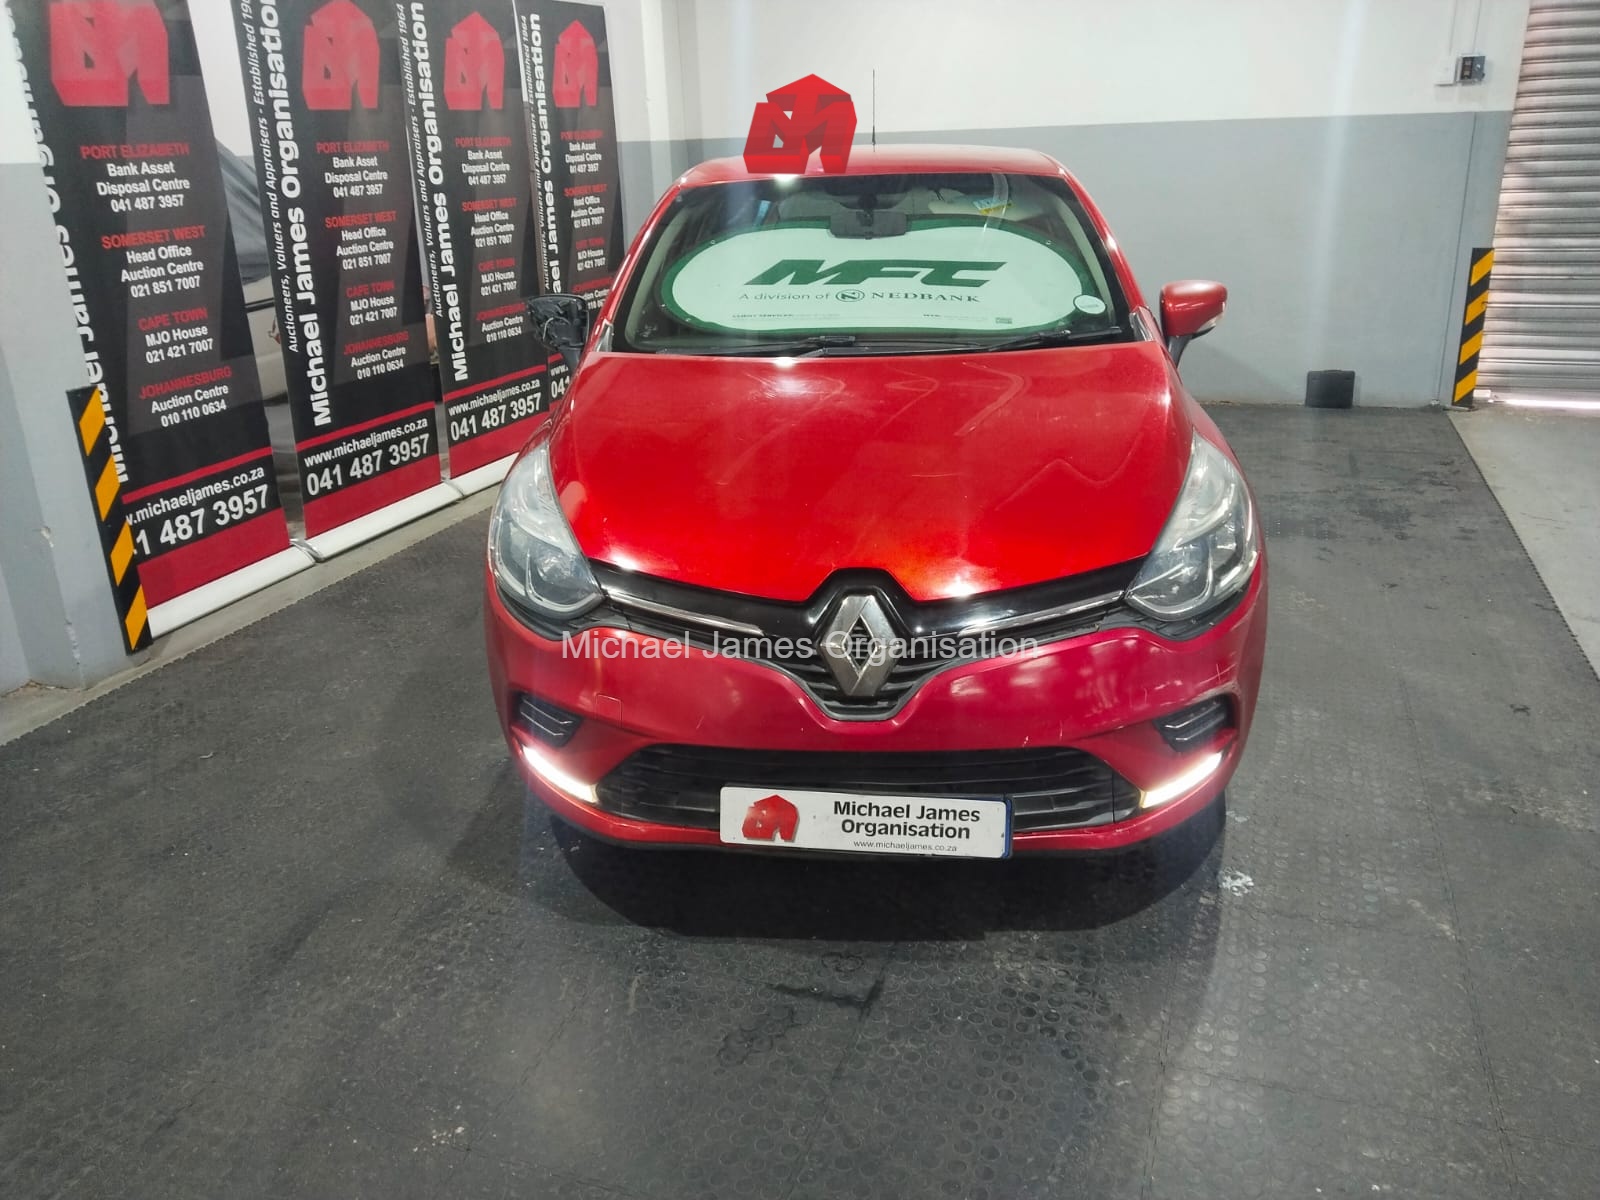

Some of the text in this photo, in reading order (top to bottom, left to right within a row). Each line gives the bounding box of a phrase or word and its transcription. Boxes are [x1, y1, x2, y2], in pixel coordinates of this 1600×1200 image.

[396, 3, 407, 34] 1964
[243, 23, 264, 105] Established
[400, 36, 416, 105] Established
[530, 13, 552, 174] Organisation
[80, 143, 190, 159] PORT ELIZABETH
[259, 115, 277, 190] Appraisers
[411, 115, 425, 178] Appraisers
[106, 161, 175, 177] Bank Asset
[332, 156, 378, 169] Bank Asset
[96, 177, 190, 197] Disposal Centre
[324, 170, 388, 185] Disposal Centre
[110, 194, 184, 212] 041 487 3957
[333, 184, 383, 198] 041 487 3957
[410, 2, 469, 381] Michael James Organisation
[418, 179, 428, 202] and
[266, 191, 280, 218] and
[544, 180, 558, 254] James
[101, 225, 205, 249] SOMERSET WEST
[341, 227, 386, 241] Head Office
[423, 205, 434, 246] Valuers
[126, 244, 192, 264] Head Office
[272, 222, 287, 270] Valuers
[288, 207, 315, 305] James
[336, 241, 394, 256] Auction Centre
[121, 260, 204, 283] Auction Centre
[342, 253, 391, 270] 021 851 7007
[743, 258, 1008, 288] MFC
[130, 275, 200, 298] 021 851 7007
[431, 250, 443, 317] Auctioneers,
[350, 295, 394, 312] MJO House
[754, 292, 810, 301] division
[815, 292, 830, 301] of
[871, 292, 980, 302] NEDBANK
[138, 307, 208, 331] CAPE TOWN
[280, 274, 298, 352] Auctioneers,
[350, 307, 398, 326] 021 421 7007
[145, 325, 208, 347] MJO House
[145, 338, 214, 364] 021 421 7007
[350, 346, 406, 367] Auction Centre
[299, 313, 332, 426] Michael
[357, 359, 404, 380] 010 110 0634
[140, 366, 232, 399] JOHANNESBURG
[150, 383, 229, 414] Auction Centre
[448, 378, 540, 416] www.michaeljames.co.za
[160, 399, 227, 427] 010 110 0634
[450, 392, 541, 441] 041 487 3957
[304, 417, 428, 468] www.michaeljames.co.za
[306, 433, 430, 496] 041 487 3957
[159, 508, 206, 548] 487
[212, 484, 269, 526] 3957
[833, 800, 981, 822] Michael James
[841, 819, 970, 840] Organisation
[853, 840, 958, 853] www.michaeljames.co.za
